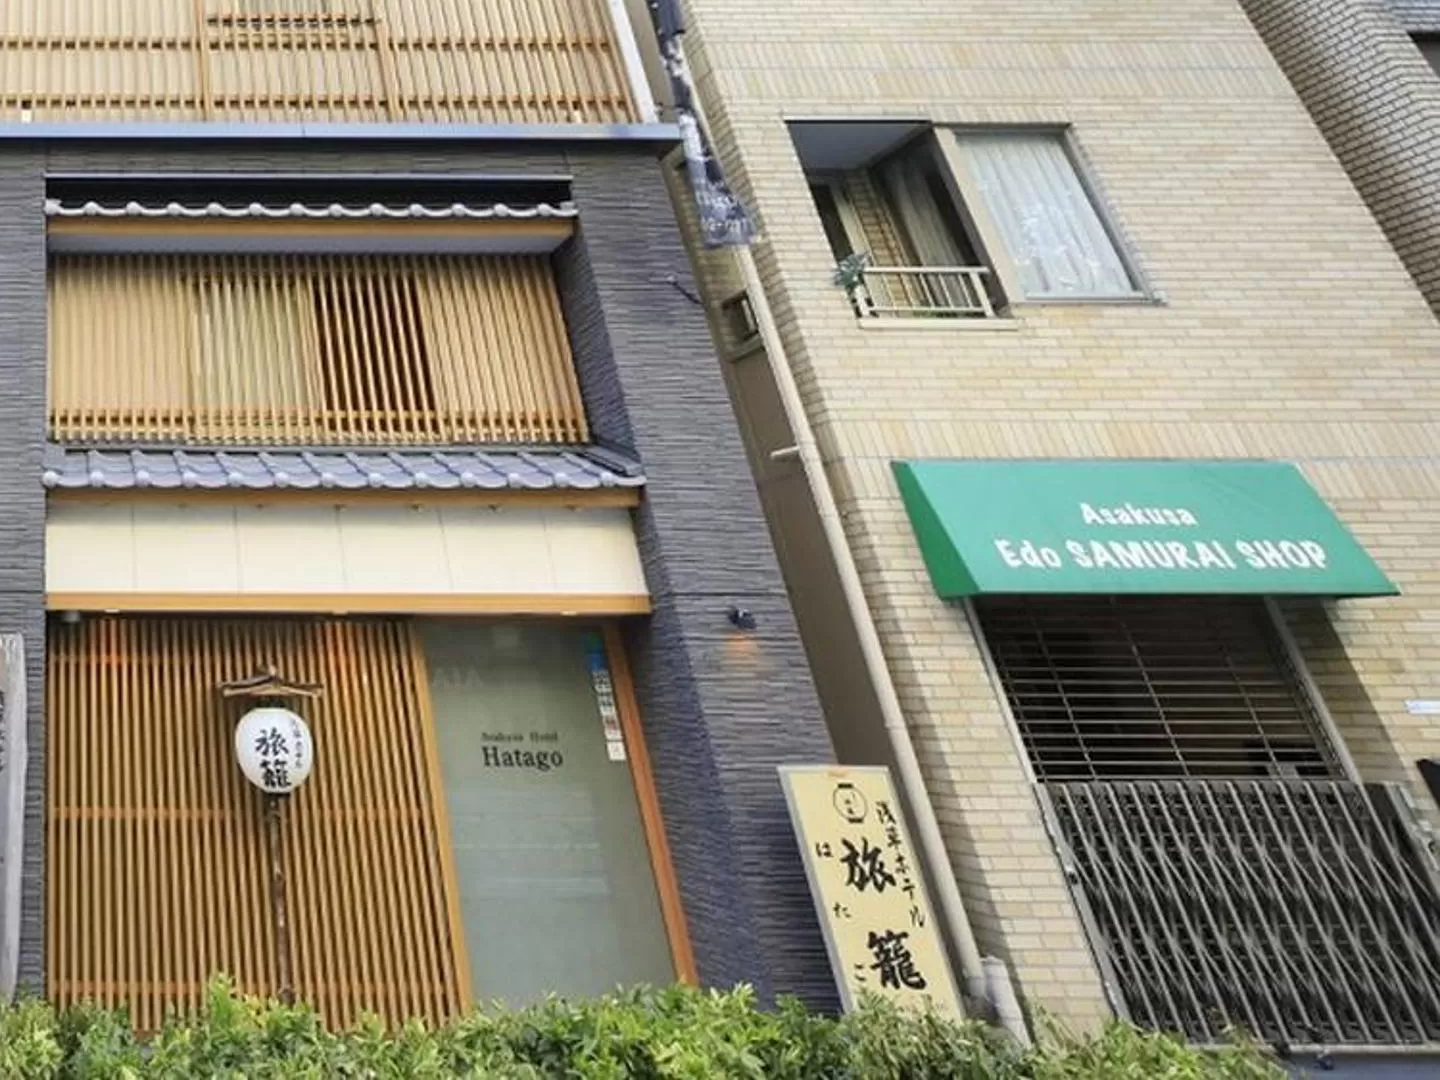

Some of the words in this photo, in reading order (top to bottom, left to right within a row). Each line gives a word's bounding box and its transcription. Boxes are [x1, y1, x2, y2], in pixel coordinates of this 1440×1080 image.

[1080, 502, 1198, 525] Asakusa
[994, 538, 1061, 569] Edo
[1065, 539, 1236, 570] SAMURAI
[1235, 539, 1327, 570] SHOP
[254, 726, 292, 788] 旅籠
[481, 746, 564, 771] Hatago
[840, 837, 928, 990] 旅籠
